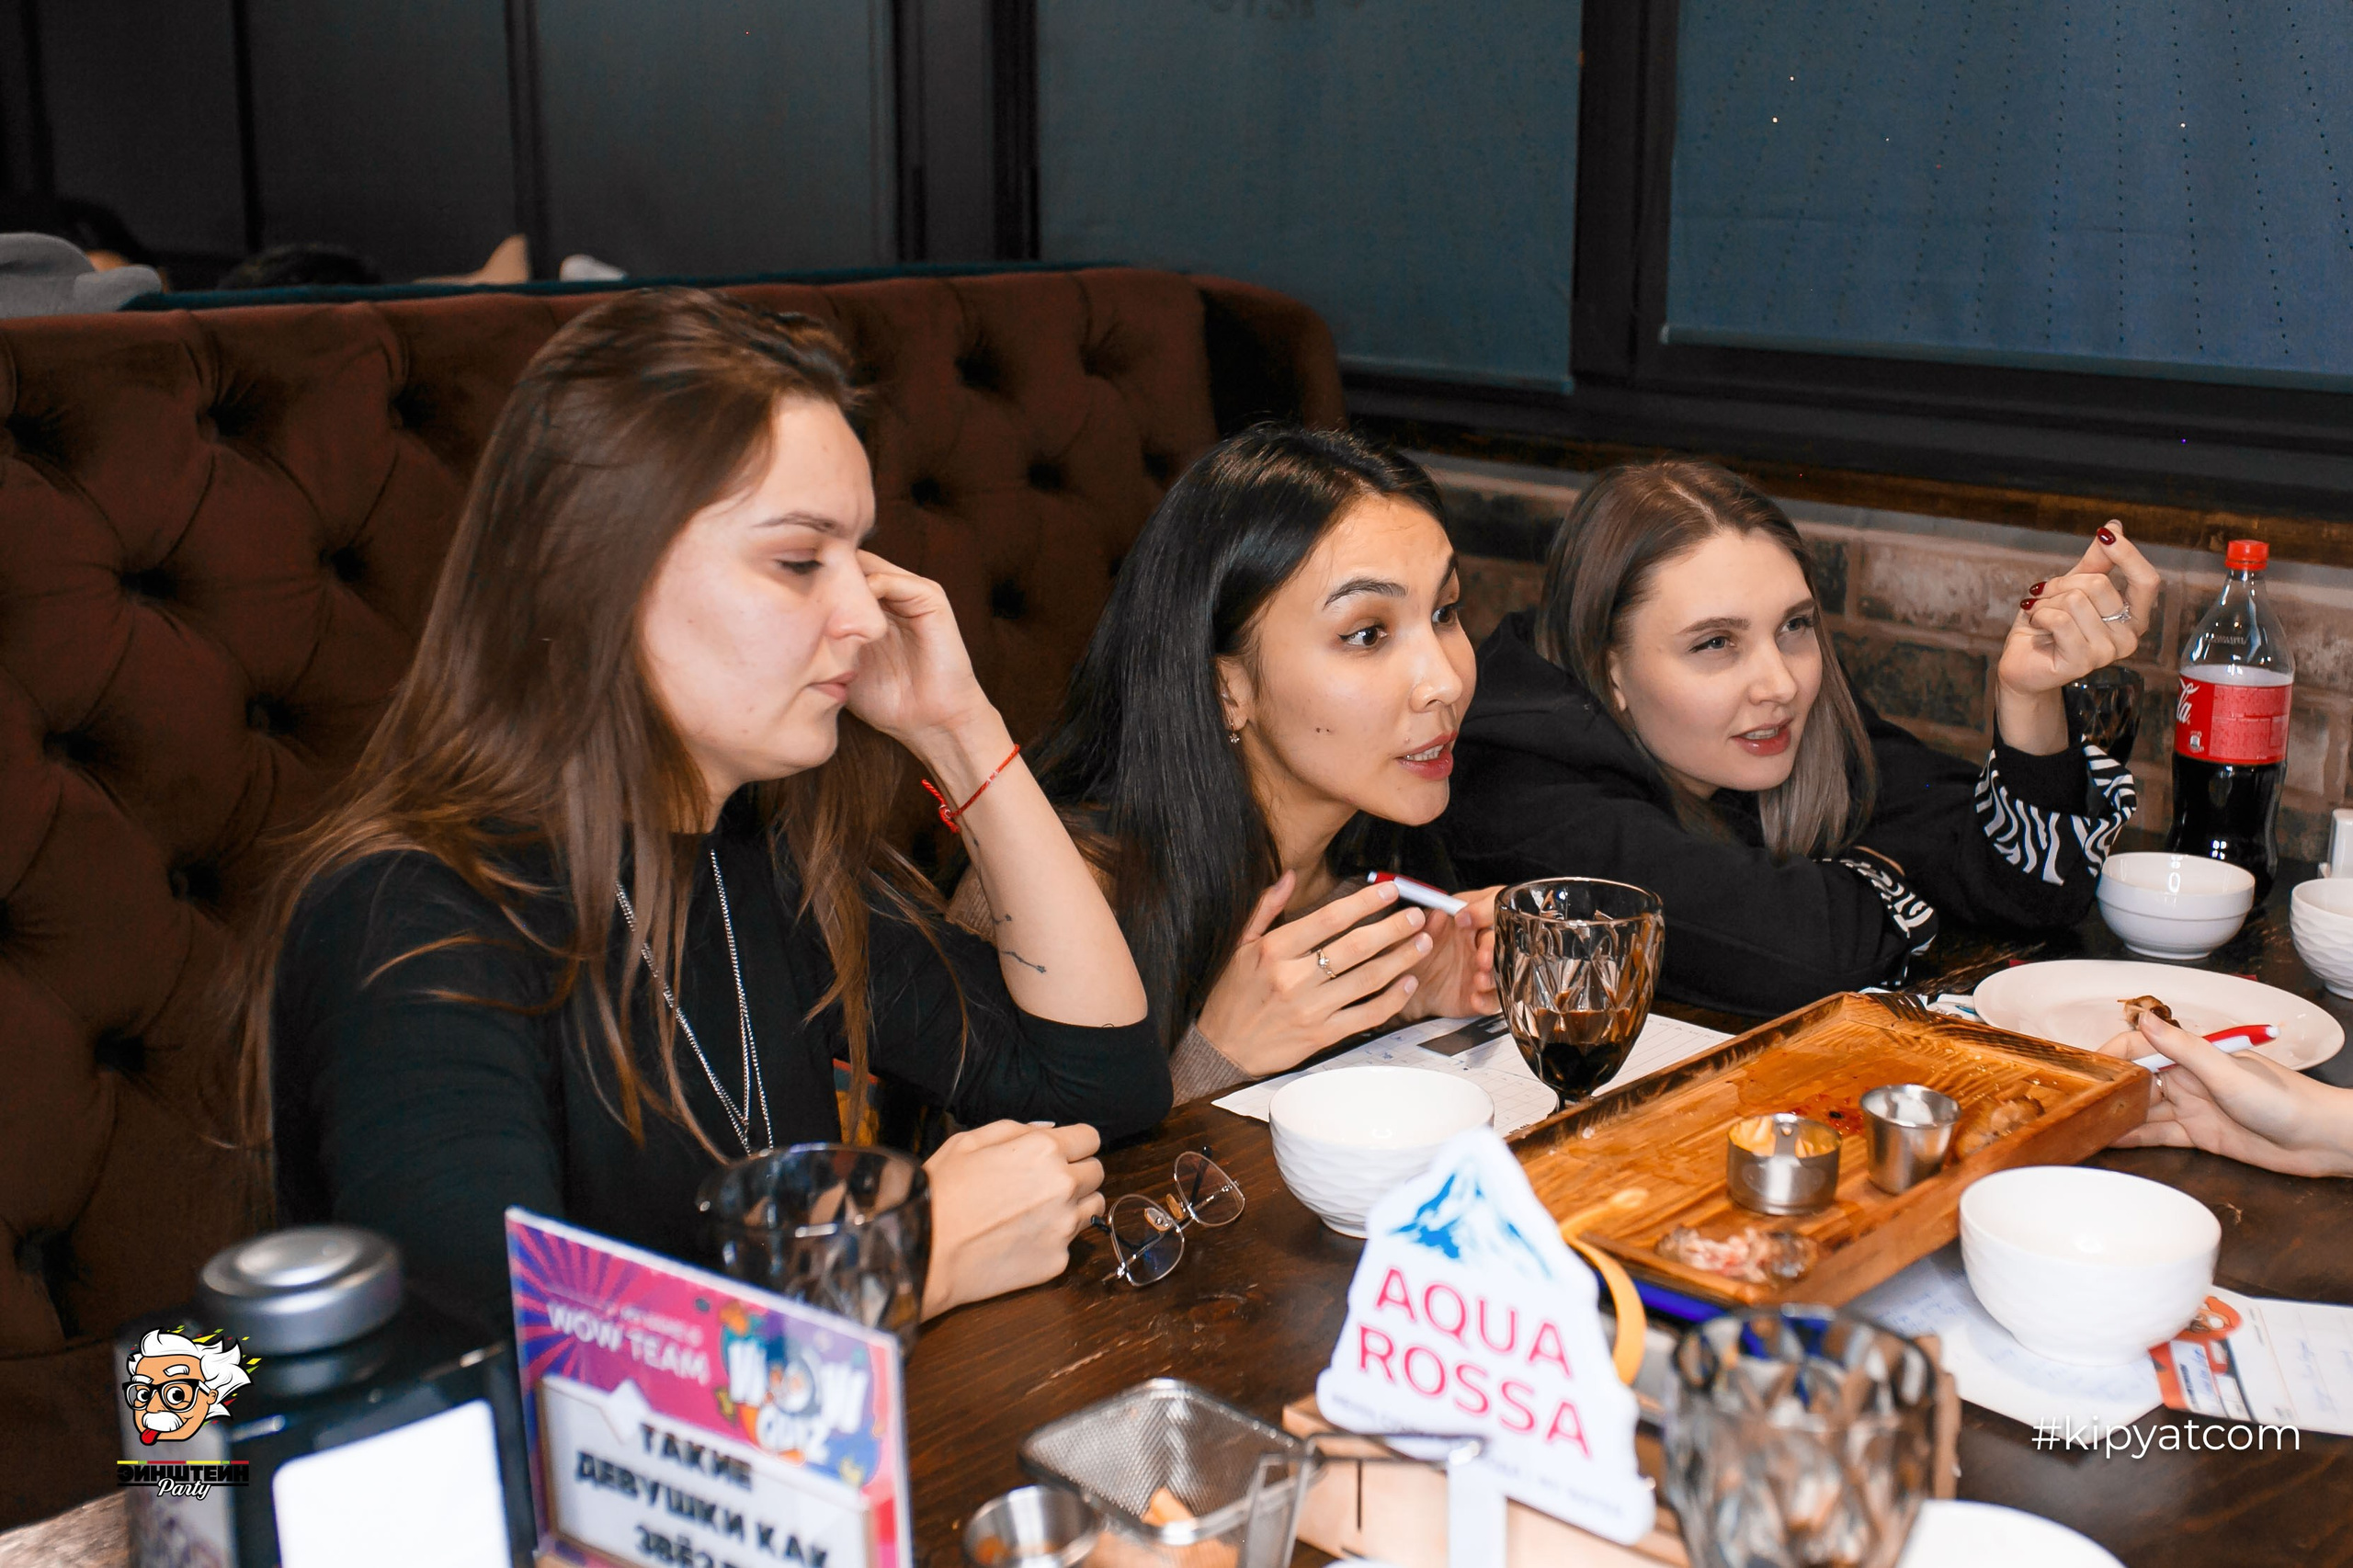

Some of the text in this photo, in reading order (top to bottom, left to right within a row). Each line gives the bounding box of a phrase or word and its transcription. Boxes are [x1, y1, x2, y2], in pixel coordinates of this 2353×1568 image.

[546, 1299, 623, 1353] WOW
[625, 1329, 711, 1386] TEAM
[1374, 1267, 1574, 1381] AQUA
[1357, 1322, 1594, 1460] ROSSA
[574, 1449, 828, 1568] ДЕВУШКИ КАК
[640, 1421, 753, 1493] ТАКИЕ
